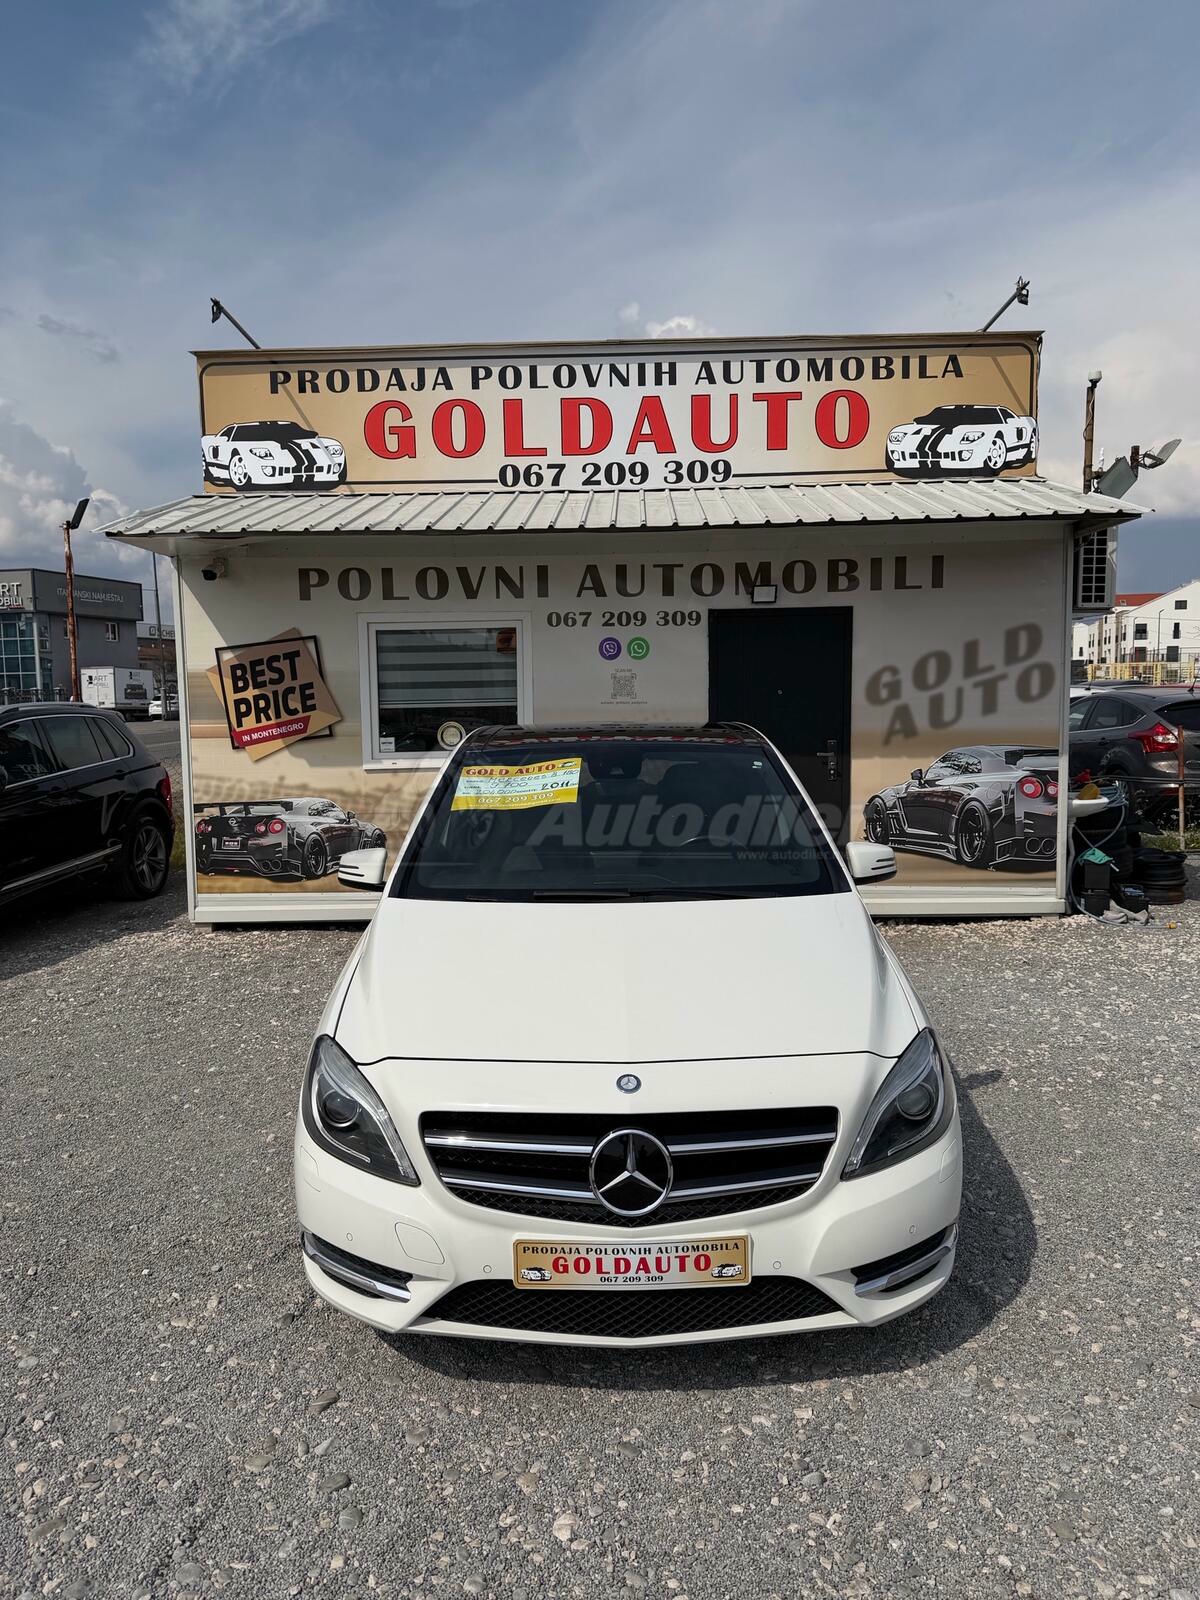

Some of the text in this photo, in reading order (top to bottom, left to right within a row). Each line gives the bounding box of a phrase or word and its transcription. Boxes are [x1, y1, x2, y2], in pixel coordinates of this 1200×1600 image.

[268, 354, 965, 395] PRODAJA POLOVNIH AUTOMOBILA
[363, 388, 870, 459] GOLDAUTO
[498, 459, 733, 488] 067 209 309
[297, 554, 945, 601] POLOVNI AUTOMOBILI
[546, 609, 702, 628] 067 209 309
[230, 650, 301, 694] BEST
[864, 622, 1043, 706] GOLD
[233, 682, 317, 728] PRICE
[883, 660, 1056, 746] AUTO
[241, 722, 304, 742] IN MONTENEGRO
[465, 763, 556, 776] GOLD AUTO
[478, 792, 554, 804] 067 209 309
[522, 1242, 740, 1256] PRODAJA POLOVNIH AUTOMOBILA
[551, 1253, 712, 1275] GOLDAUTO
[599, 1276, 619, 1284] 067
[644, 1275, 664, 1283] 309
